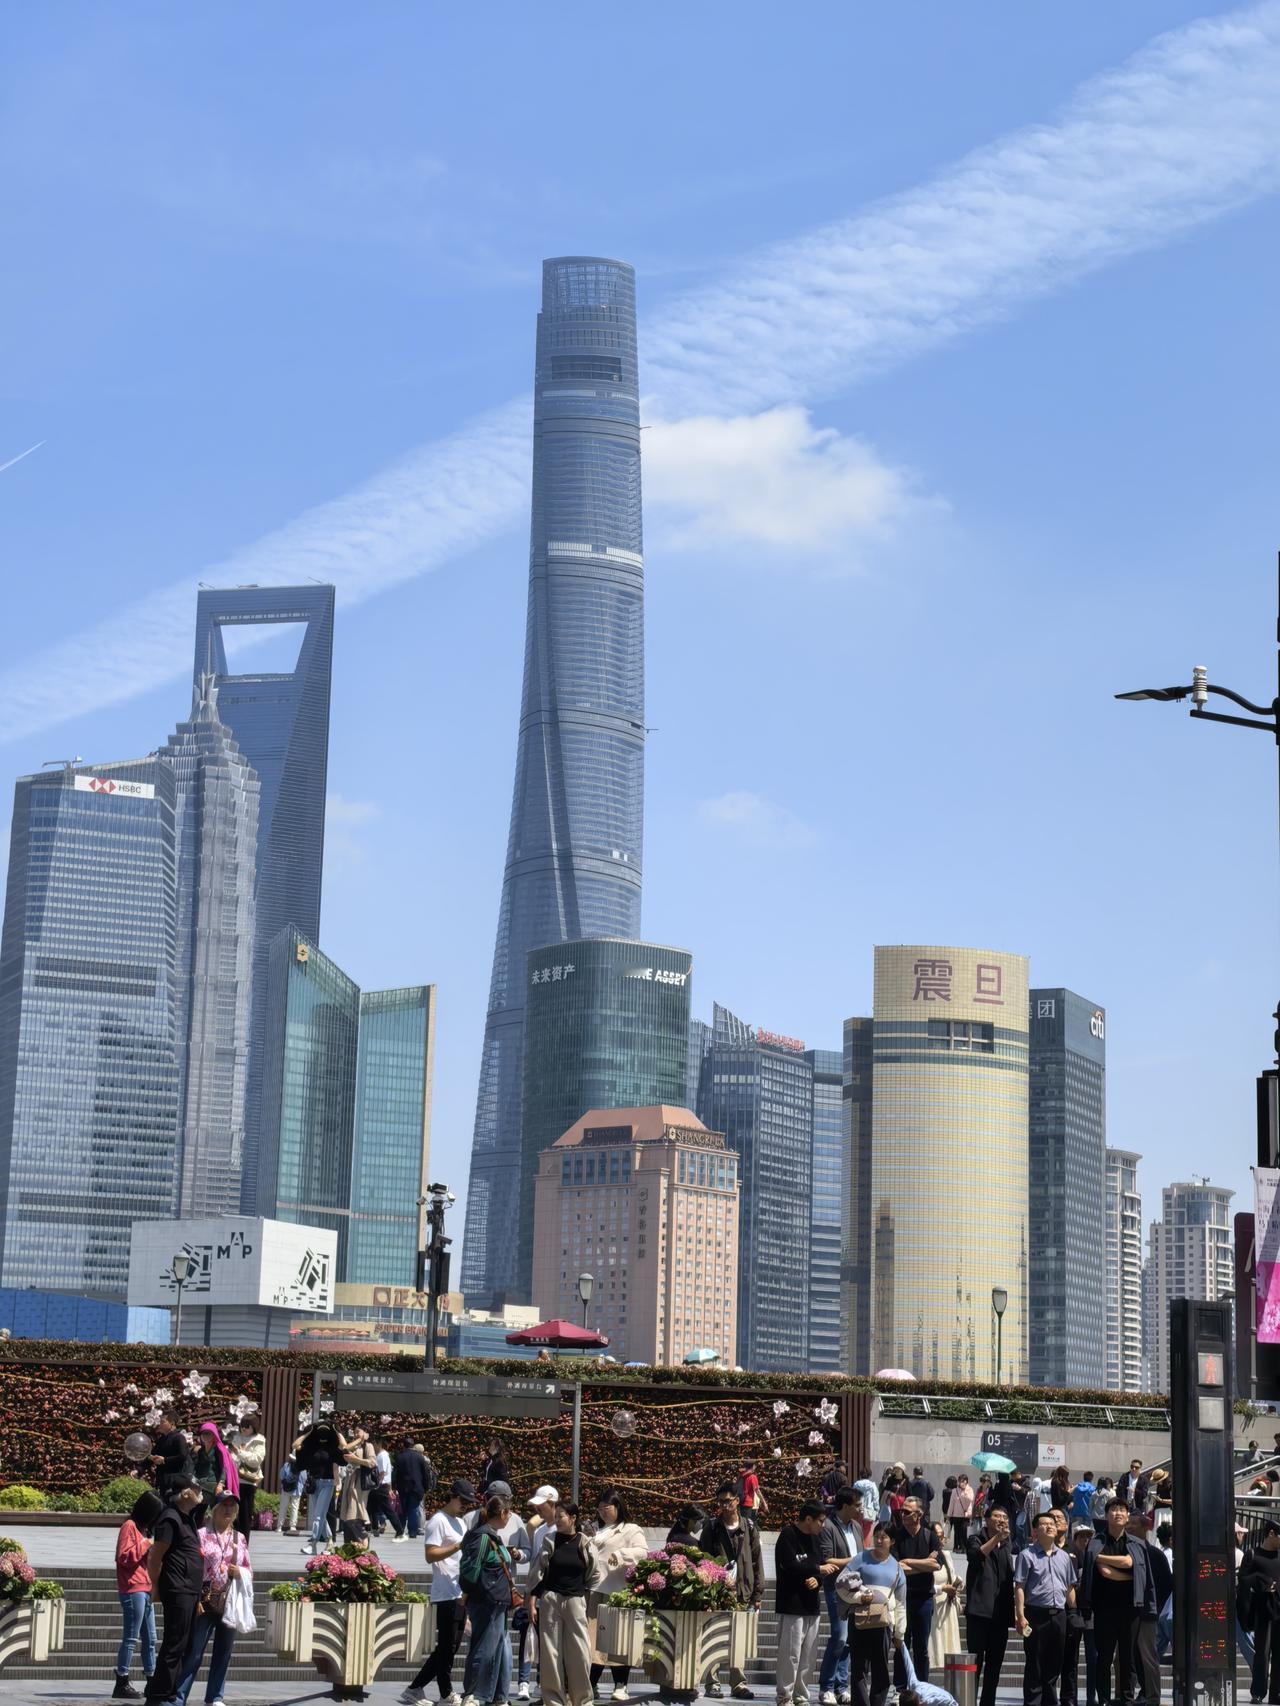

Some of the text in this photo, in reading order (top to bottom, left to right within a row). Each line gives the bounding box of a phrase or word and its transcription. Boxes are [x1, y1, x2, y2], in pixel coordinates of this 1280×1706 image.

[118, 784, 142, 794] HSBC
[531, 963, 576, 985] 未来资产
[654, 969, 687, 987] ASSET
[912, 958, 1005, 1006] 震旦
[1090, 1013, 1105, 1040] citi
[217, 1231, 253, 1259] MAP
[987, 1433, 1001, 1446] 05
